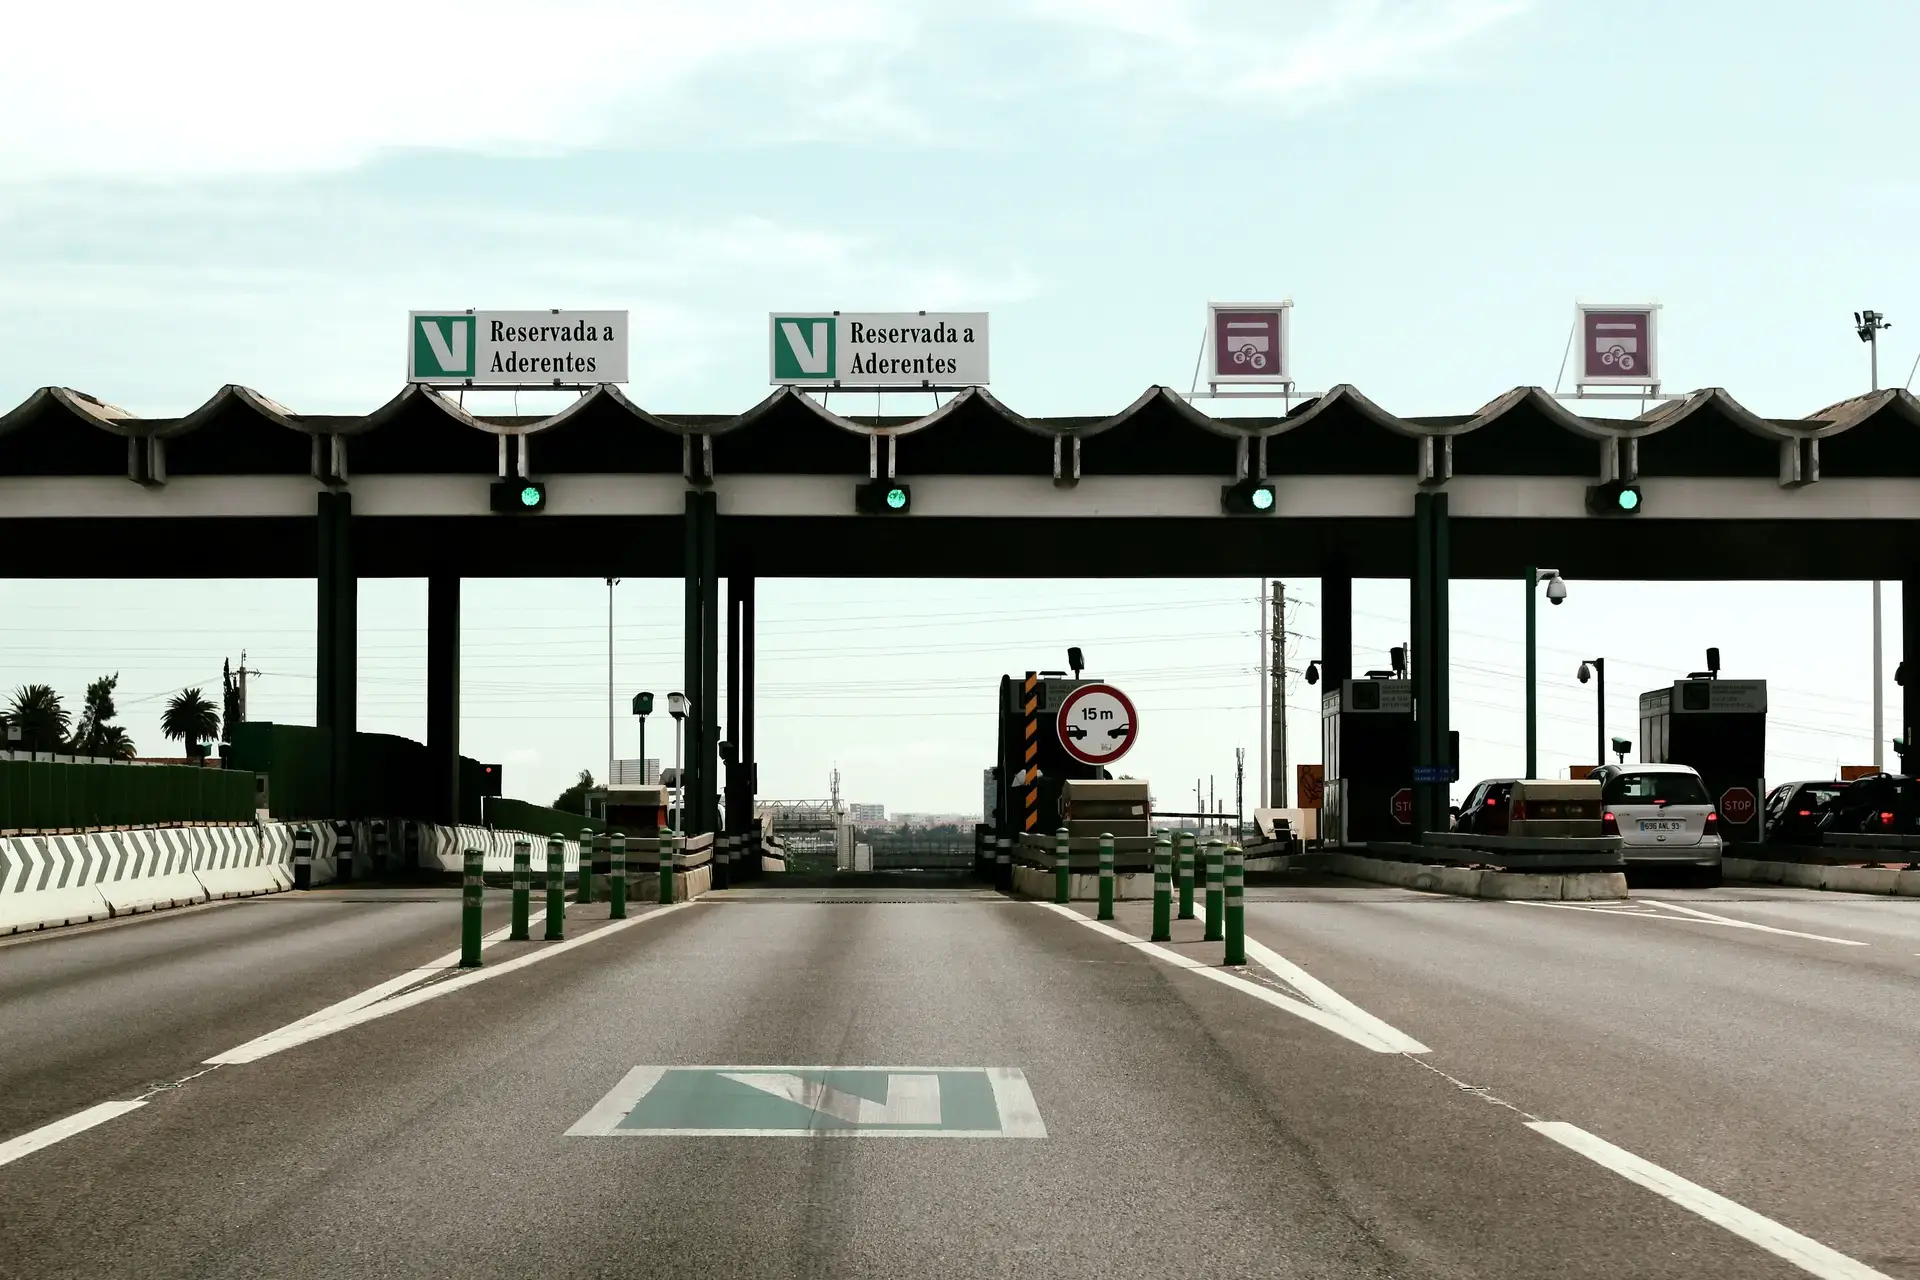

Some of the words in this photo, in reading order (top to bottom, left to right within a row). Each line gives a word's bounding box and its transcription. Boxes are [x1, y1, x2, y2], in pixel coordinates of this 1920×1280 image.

[490, 320, 597, 342] Reservada
[603, 326, 615, 342] a
[850, 321, 958, 344] Reservada
[964, 327, 975, 343] a
[490, 351, 597, 373] Aderentes
[850, 352, 957, 374] Aderentes
[1082, 708, 1097, 721] 15
[1100, 710, 1113, 720] m
[1724, 801, 1751, 811] STOP
